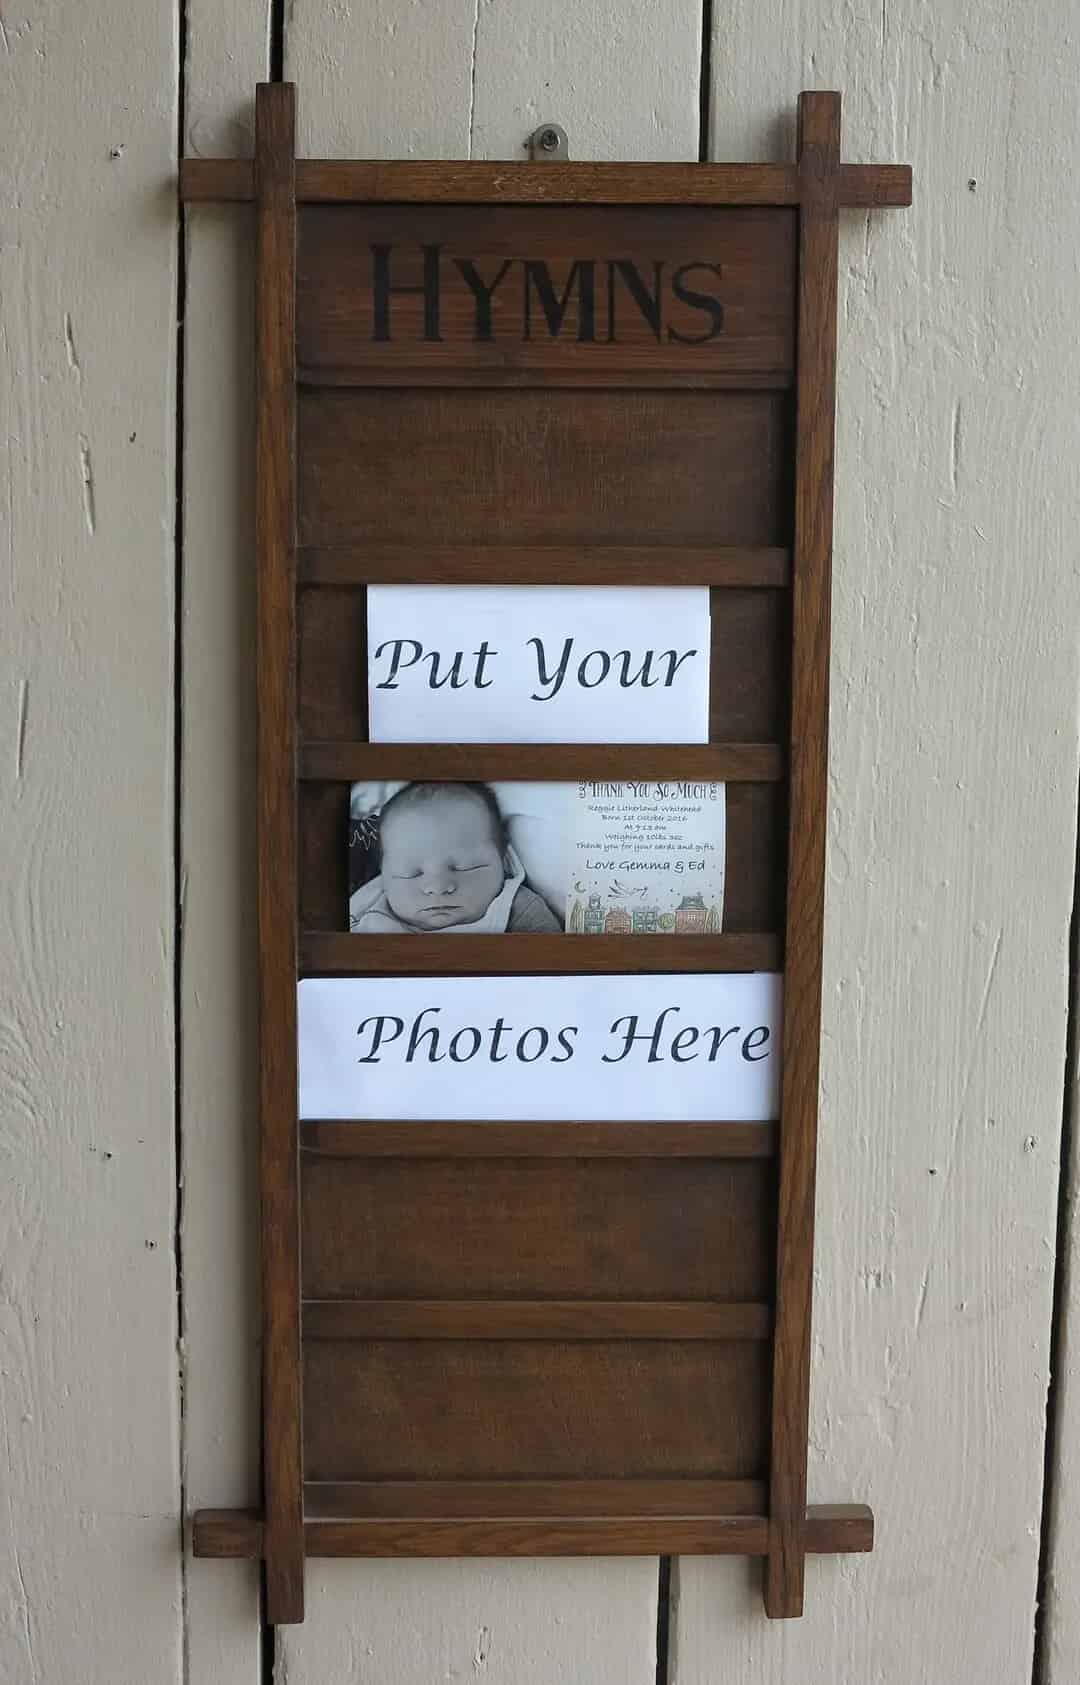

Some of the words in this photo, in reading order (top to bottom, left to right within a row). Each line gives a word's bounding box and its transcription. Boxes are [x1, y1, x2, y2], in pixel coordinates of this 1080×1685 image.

[370, 243, 725, 345] HYMNS
[374, 639, 498, 689] Put
[526, 637, 698, 701] Your
[605, 834, 644, 842] Weighing
[634, 844, 652, 852] your
[695, 844, 714, 852] gifts
[586, 860, 615, 870] Love
[619, 861, 670, 871] Gemma
[675, 860, 684, 873] &
[688, 860, 705, 870] Ed
[356, 1007, 579, 1063] Photos
[600, 1007, 772, 1063] Here
